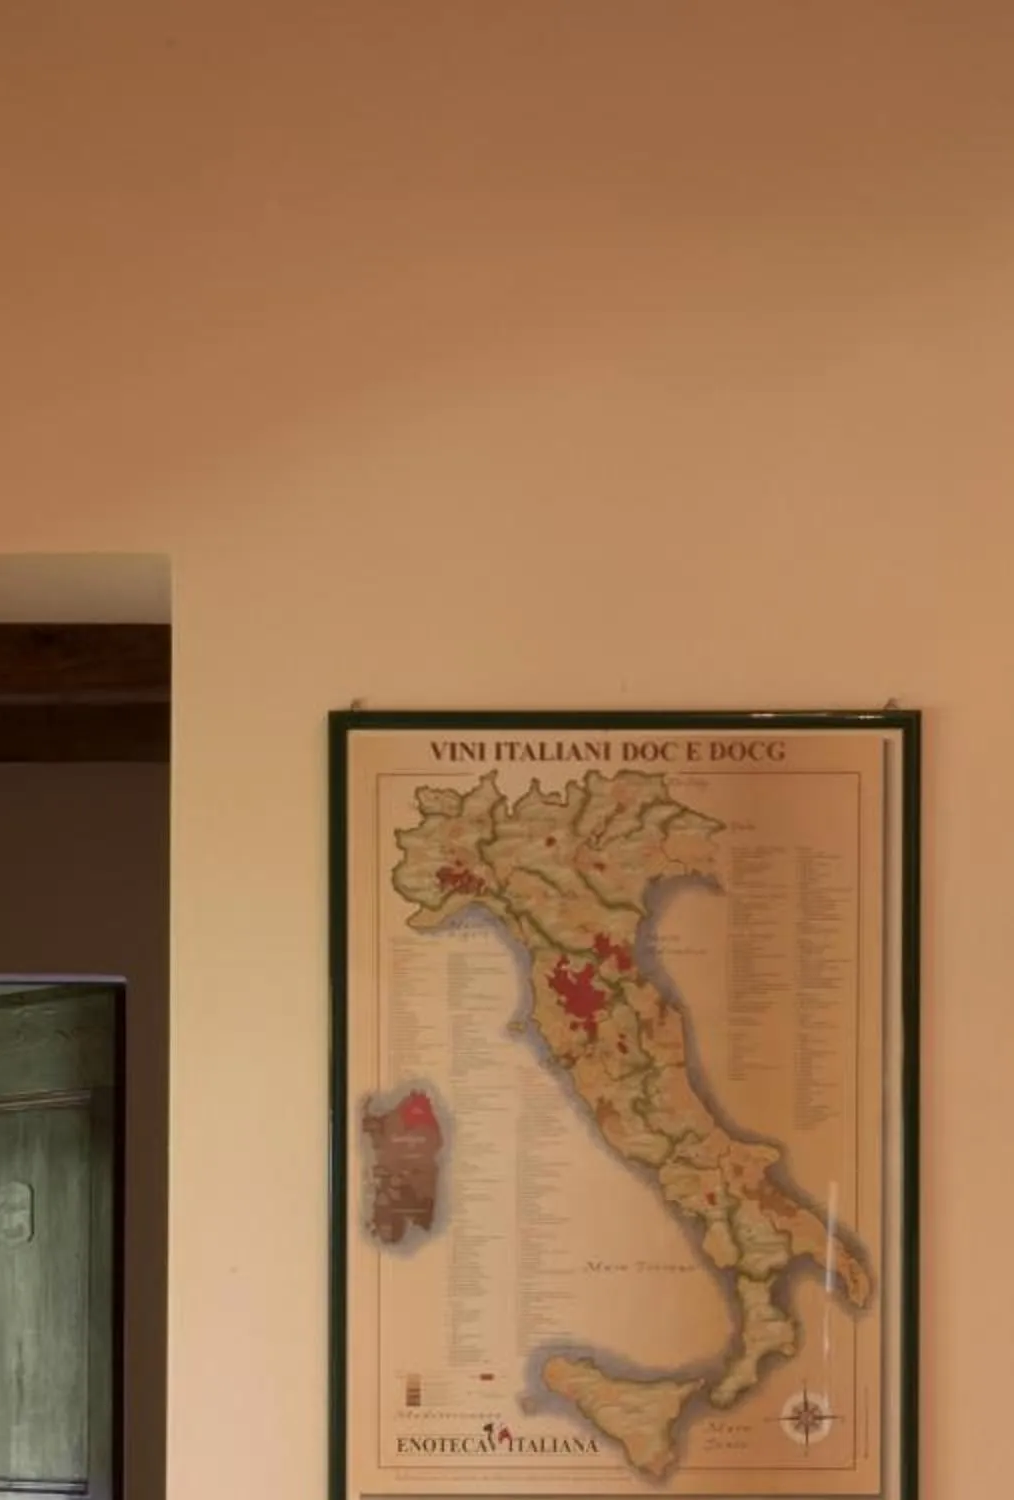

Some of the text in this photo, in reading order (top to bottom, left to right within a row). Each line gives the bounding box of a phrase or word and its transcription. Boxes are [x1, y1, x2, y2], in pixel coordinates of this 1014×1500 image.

[430, 741, 786, 762] VINI ITALIANI DOC E DOCG
[396, 1436, 600, 1453] ENOTECA ITALIANA
